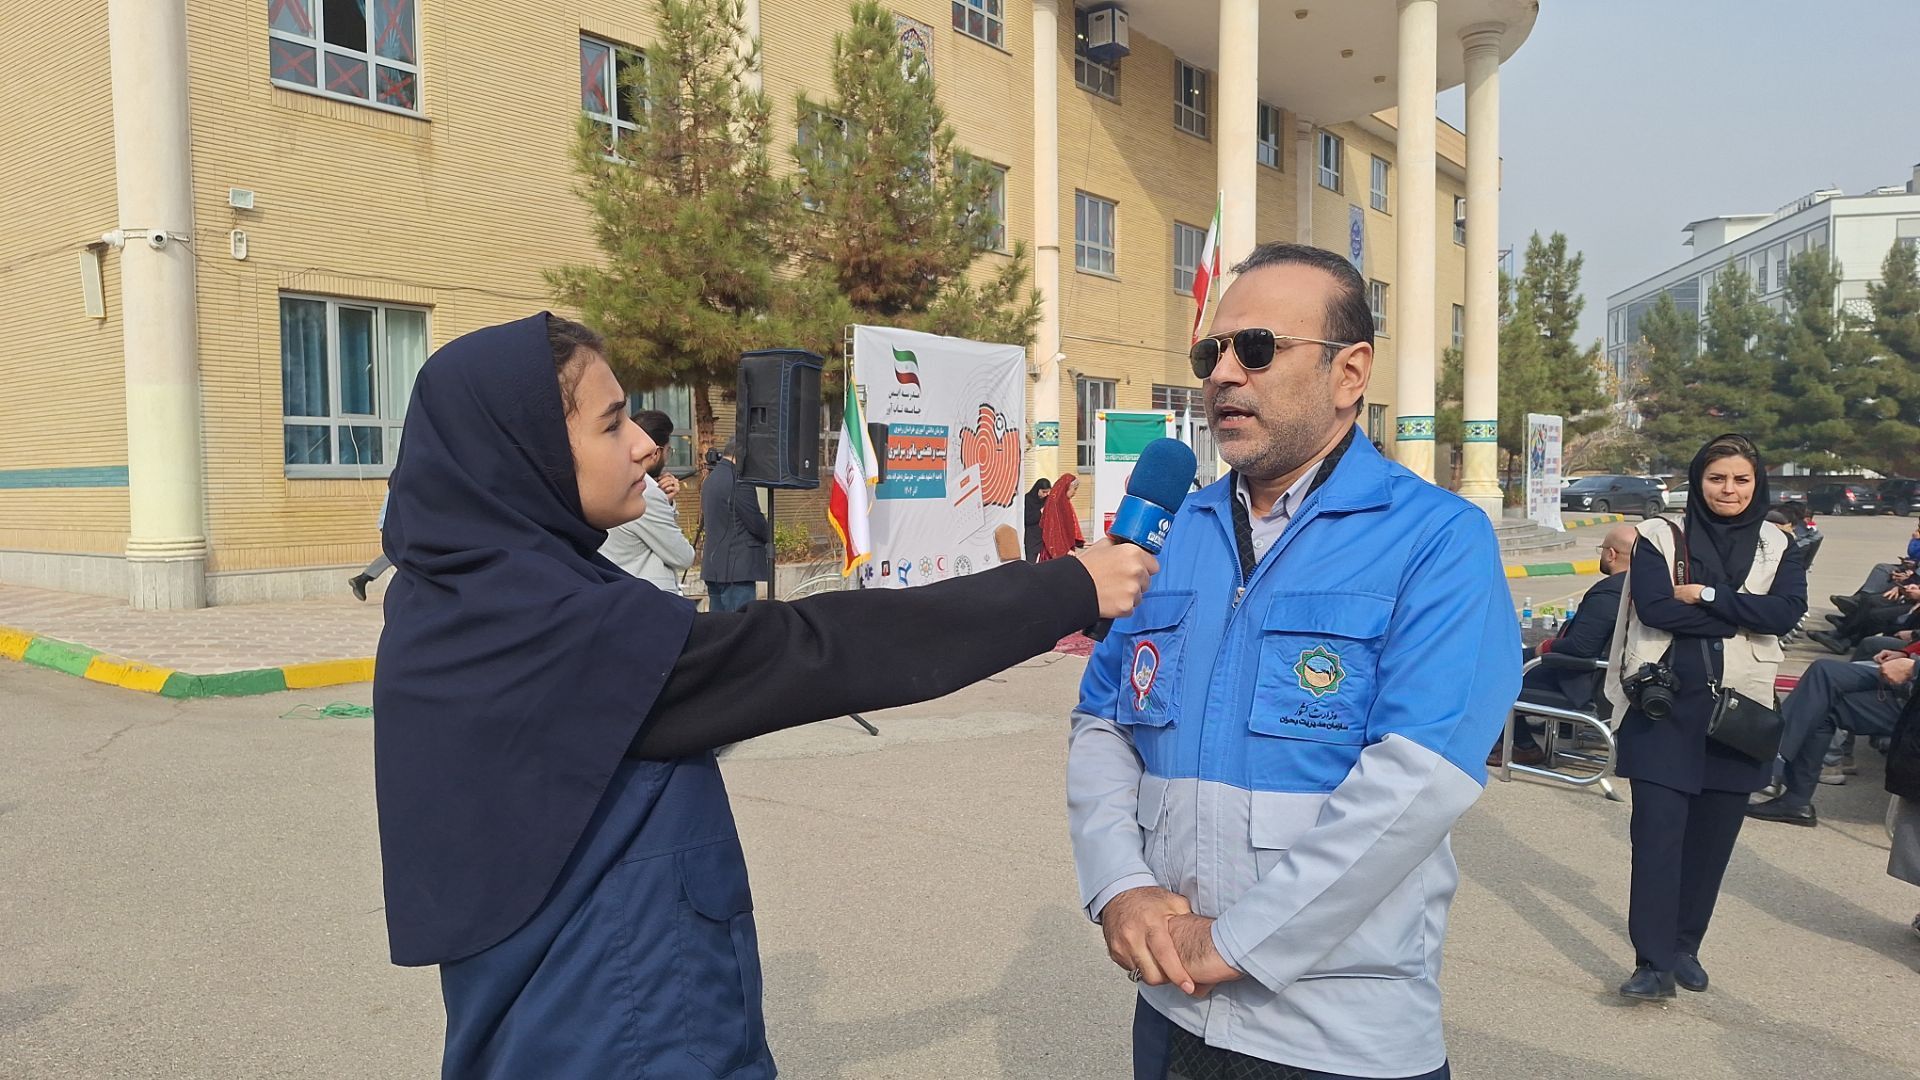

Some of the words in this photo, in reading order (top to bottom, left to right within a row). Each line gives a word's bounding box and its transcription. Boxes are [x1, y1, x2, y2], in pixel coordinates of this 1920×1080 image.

[902, 390, 920, 401] مدرسه
[904, 404, 921, 416] جامعه
[1294, 699, 1321, 716] کشور
[1308, 708, 1338, 720] وزارت
[1279, 716, 1299, 726] بحران
[1299, 718, 1326, 728] مدیریت
[1326, 721, 1349, 731] سازمان
